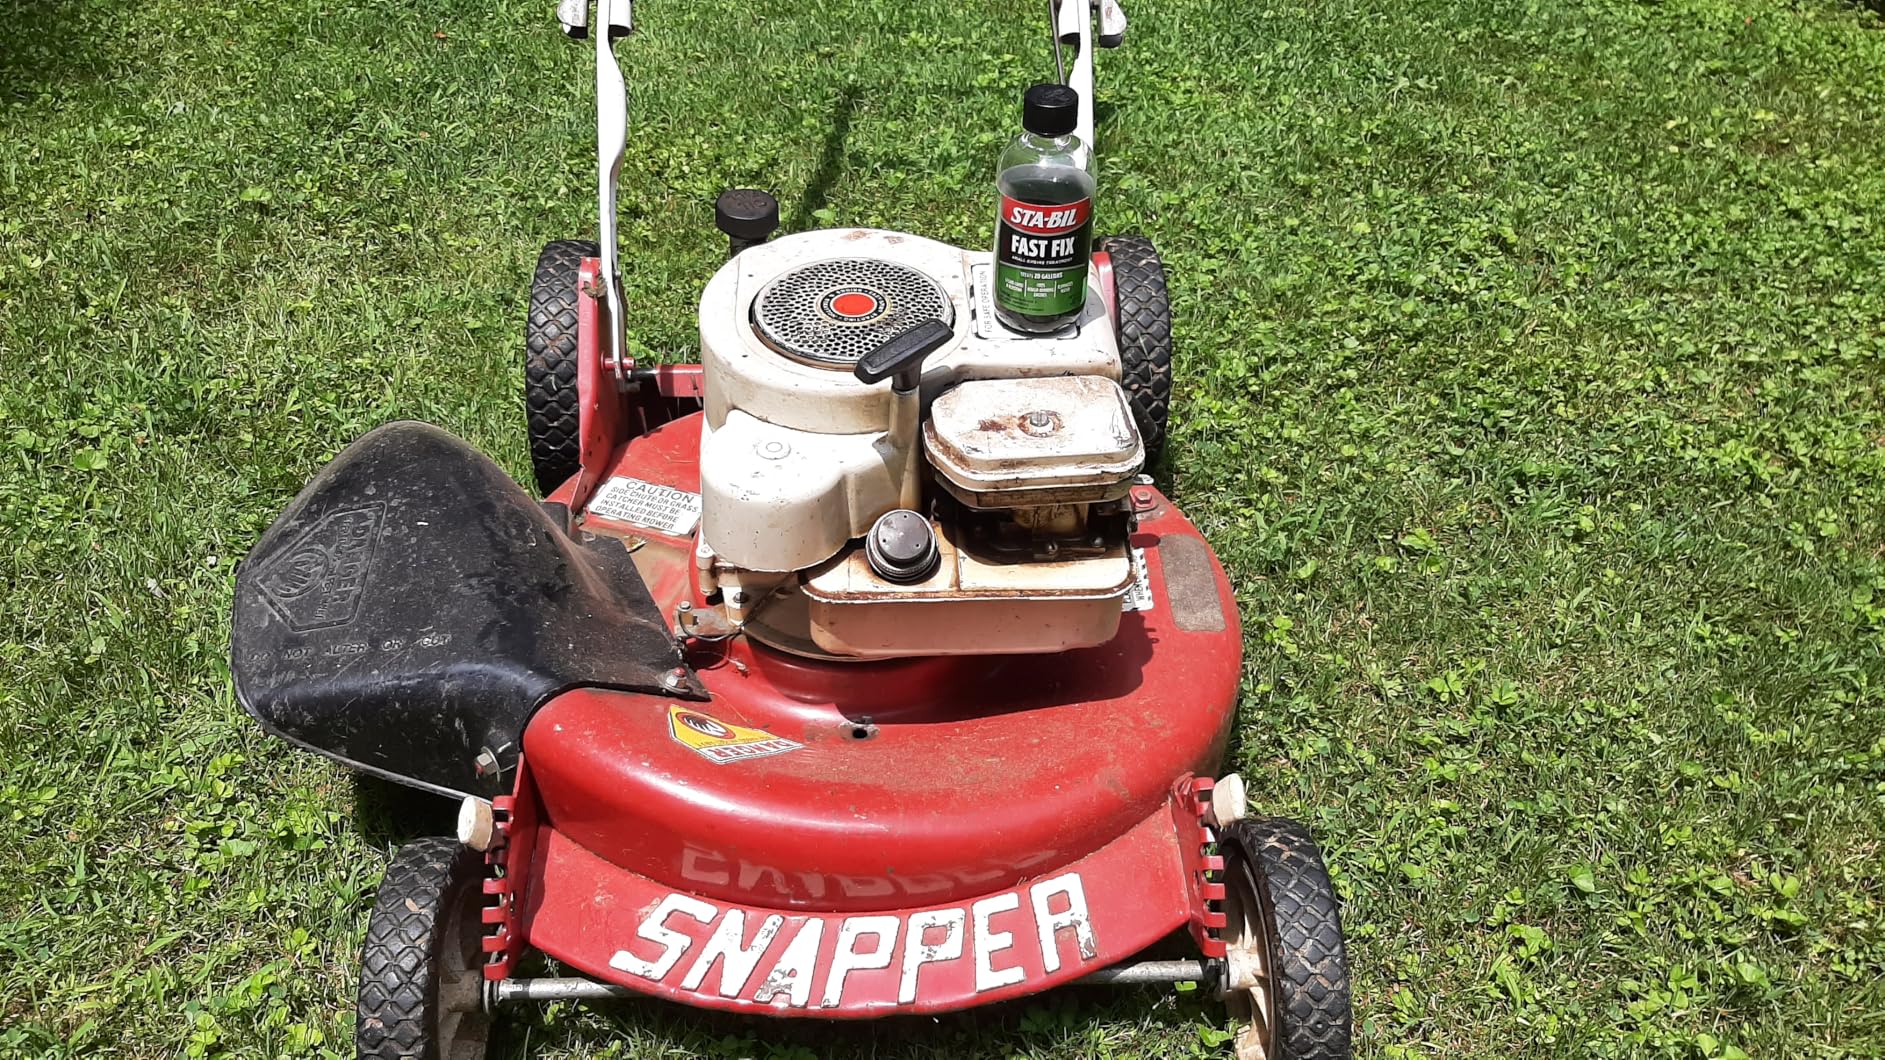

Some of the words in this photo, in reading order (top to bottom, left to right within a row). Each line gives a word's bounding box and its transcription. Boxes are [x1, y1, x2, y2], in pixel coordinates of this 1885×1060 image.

[1010, 207, 1077, 228] STA-BIL
[1011, 235, 1048, 258] FAST
[1051, 237, 1075, 258] FIX
[610, 486, 630, 496] SIDE
[630, 489, 657, 502] CHUTE
[657, 497, 669, 505] OR
[669, 499, 699, 513] GRASS
[626, 481, 694, 503] CAUTION
[600, 499, 646, 515] INSTALLED
[646, 509, 680, 523] BEFORE
[606, 493, 645, 507] CATCHER
[644, 501, 669, 512] MUST
[670, 507, 681, 515] BE
[595, 505, 642, 521] OPERATING
[642, 516, 675, 530] MOWER
[709, 740, 792, 758] DANGER
[608, 871, 1098, 1009] SNAPPER
